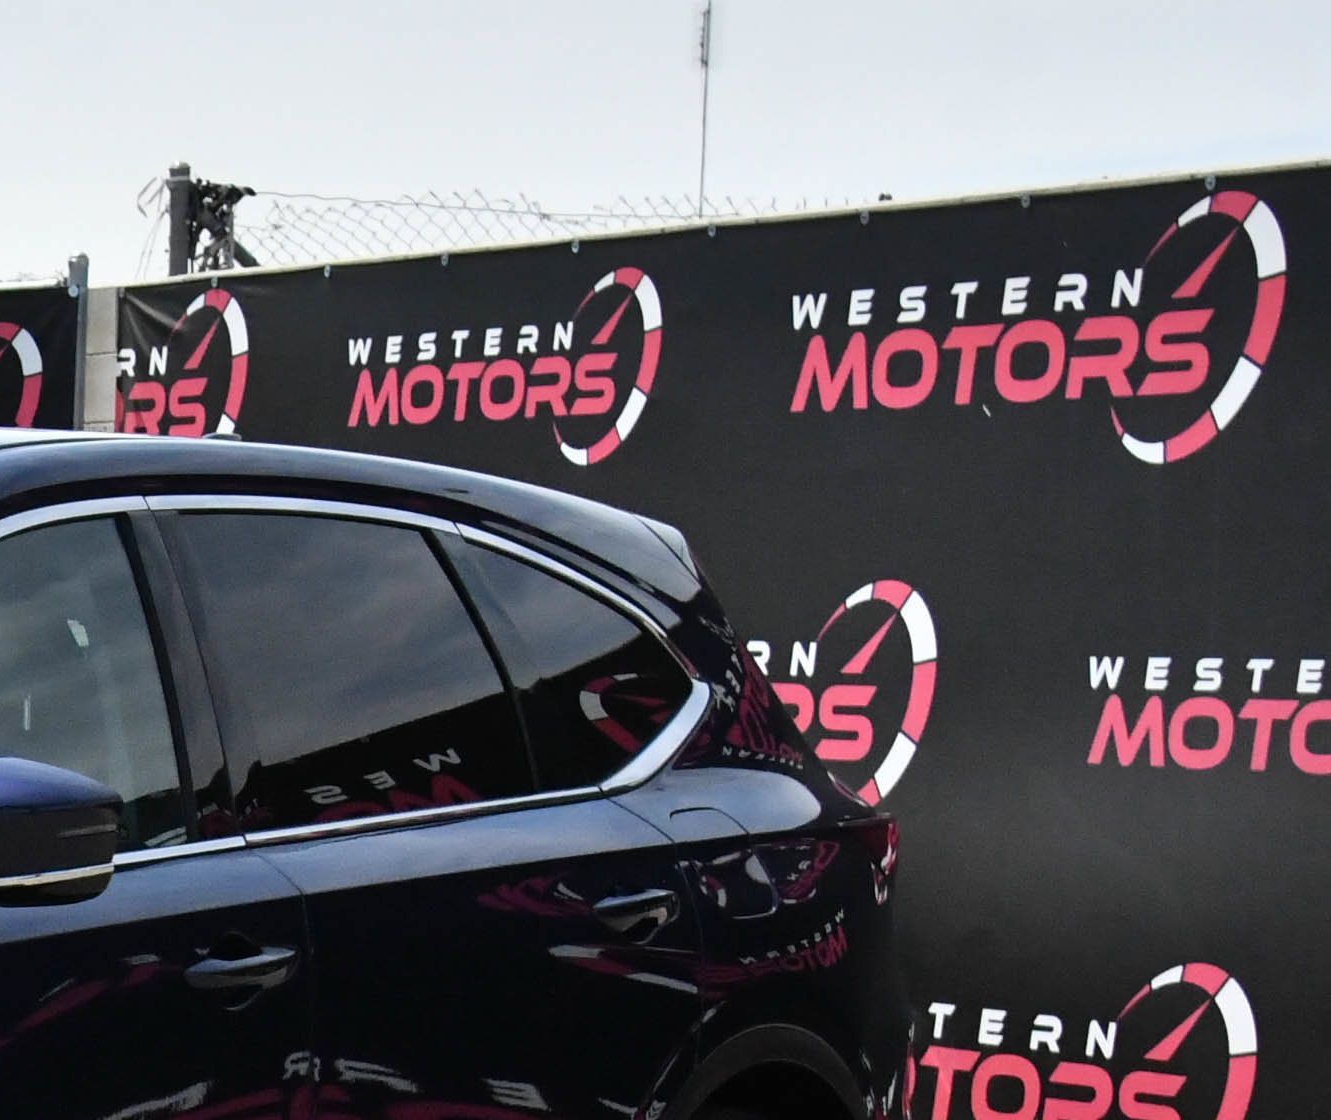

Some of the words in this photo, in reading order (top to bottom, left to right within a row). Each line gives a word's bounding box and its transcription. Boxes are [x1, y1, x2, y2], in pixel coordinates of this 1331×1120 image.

[790, 267, 1145, 332] WESTERN
[347, 320, 575, 366] WESTERN
[789, 307, 1215, 413] MOTORS
[115, 377, 208, 438] RS
[347, 351, 619, 428] MOTORS
[1089, 655, 1326, 694] WESTE
